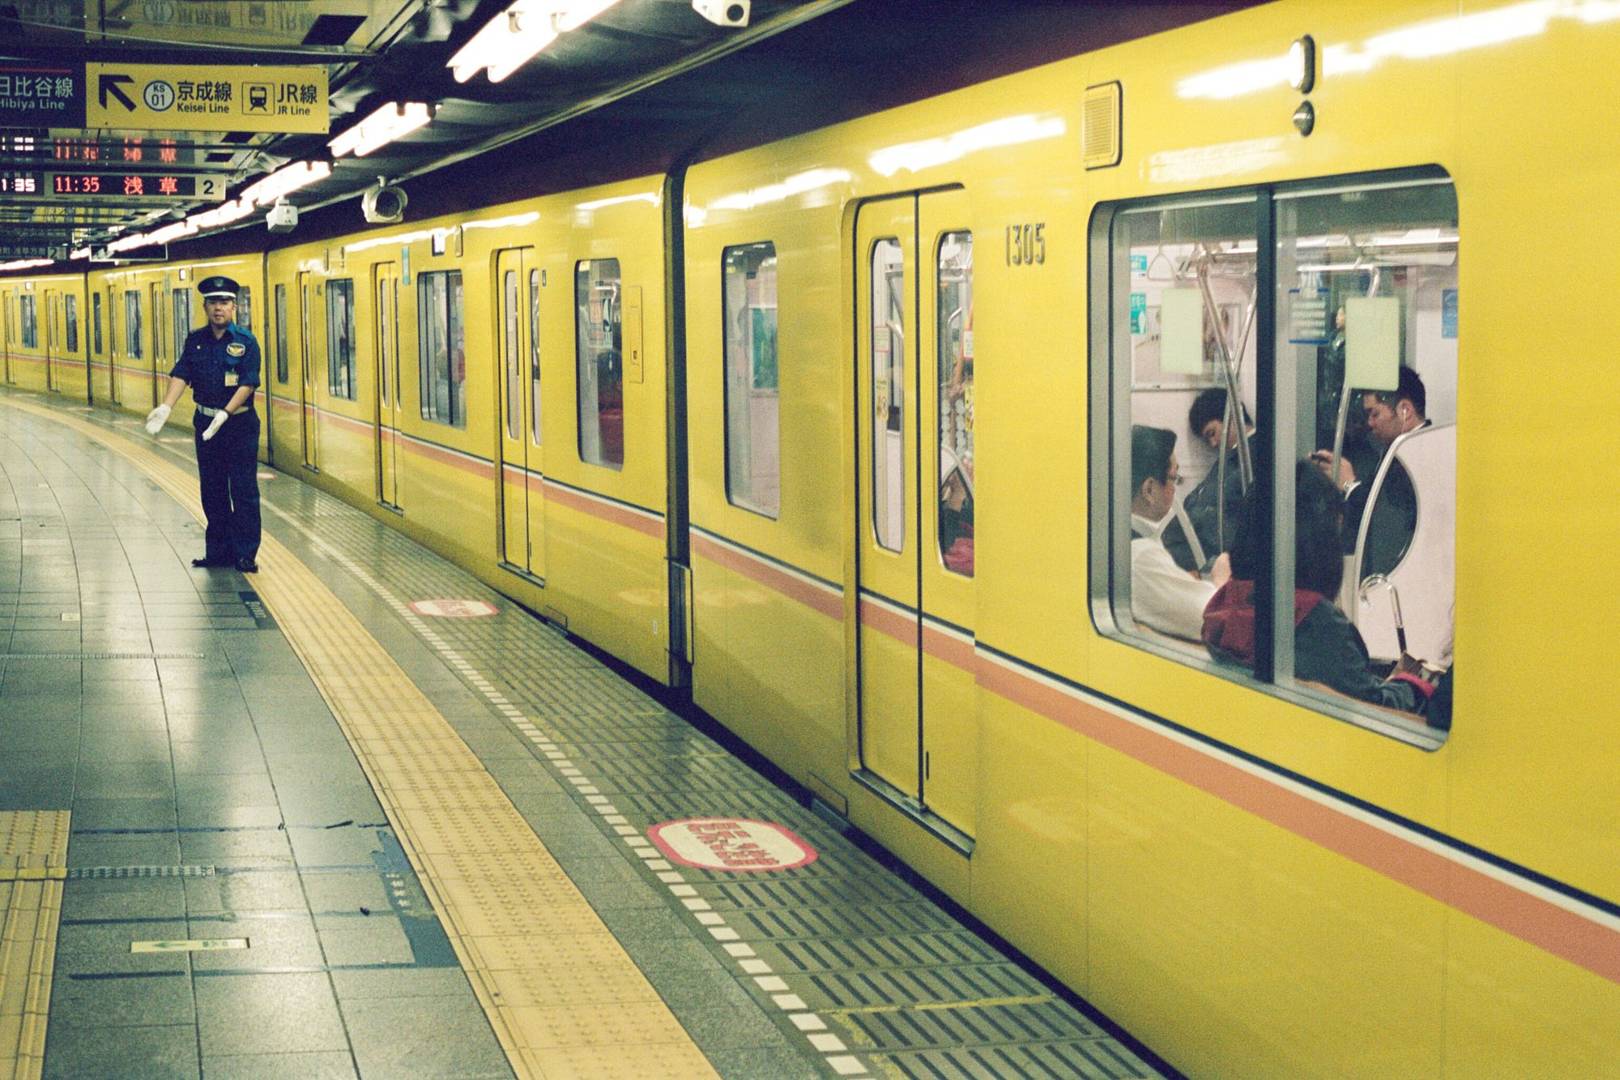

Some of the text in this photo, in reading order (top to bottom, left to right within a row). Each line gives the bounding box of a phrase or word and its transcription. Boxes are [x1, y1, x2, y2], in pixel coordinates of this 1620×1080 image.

[0, 76, 73, 98] 日比谷線
[153, 84, 166, 93] KS
[177, 80, 232, 102] 京成線
[277, 83, 318, 104] JR線
[40, 100, 65, 110] Line
[151, 94, 165, 106] 01
[177, 103, 230, 113] Keisei Line
[277, 105, 311, 116] JR Line
[56, 176, 100, 192] 11:35
[203, 180, 214, 195] 2
[1005, 222, 1046, 267] 1305
